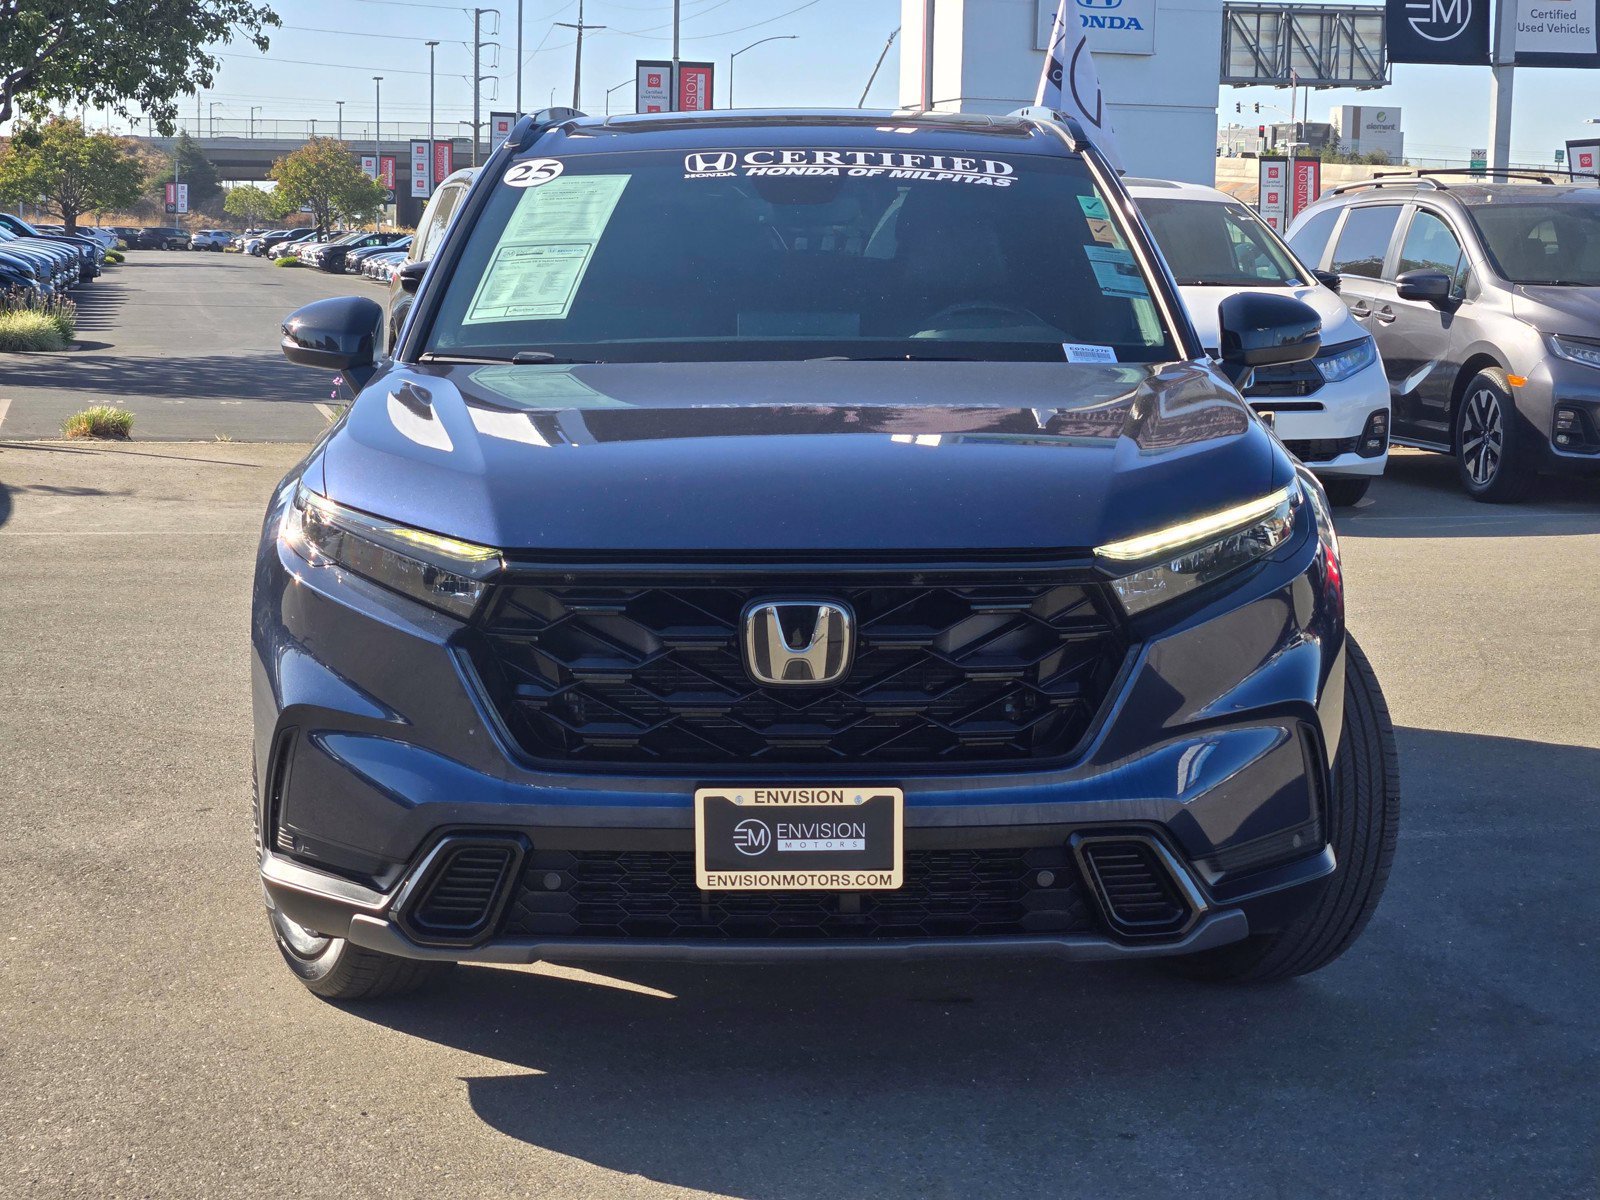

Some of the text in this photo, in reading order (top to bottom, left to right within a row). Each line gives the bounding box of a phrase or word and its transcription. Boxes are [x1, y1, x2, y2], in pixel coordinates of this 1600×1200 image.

[1530, 9, 1577, 20] Certified
[1517, 23, 1591, 34] Used Vehicles
[1366, 123, 1396, 131] element
[743, 150, 1014, 176] CERTIFIED
[508, 163, 559, 182] 25
[745, 167, 1012, 187] HONDA OF MILPITAS
[754, 790, 844, 804] ENVISION
[777, 823, 866, 839] ENVISION
[784, 841, 858, 849] MOTORS
[707, 874, 893, 887] ENVISIONMOTORS.COM
